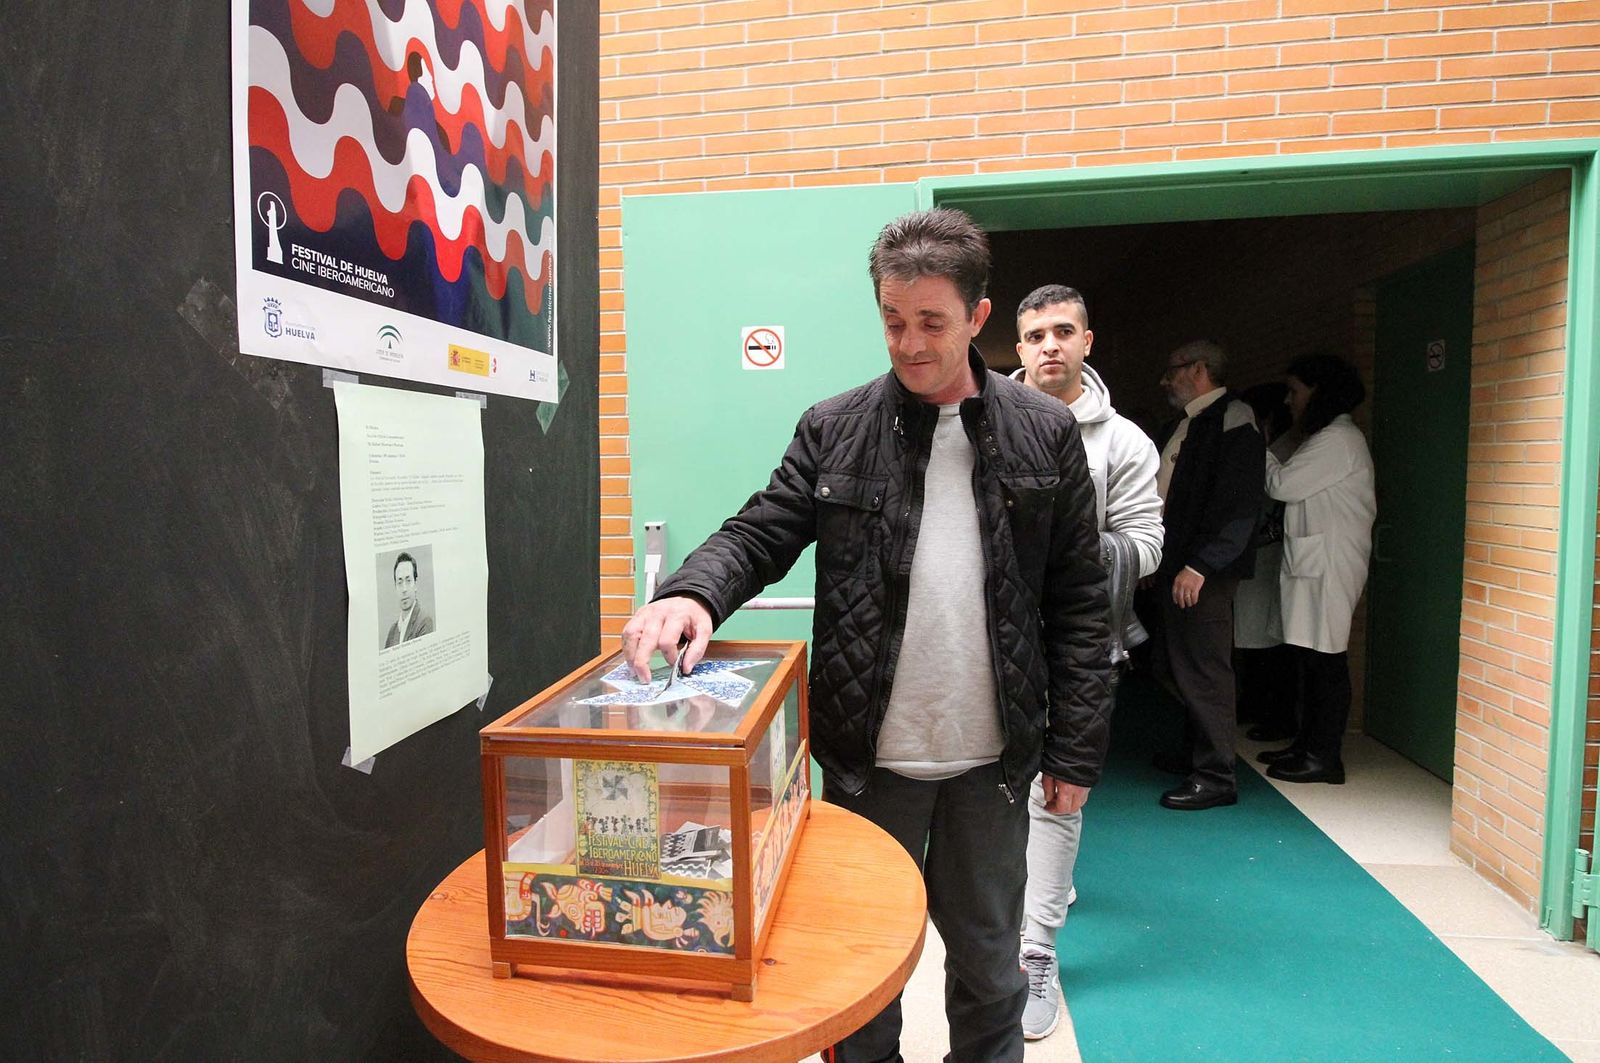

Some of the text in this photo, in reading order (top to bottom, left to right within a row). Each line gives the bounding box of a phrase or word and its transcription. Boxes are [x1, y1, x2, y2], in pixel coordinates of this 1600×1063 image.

[292, 243, 389, 285] FESTIVAL DE HUELVA
[292, 258, 395, 298] CINE IBEROAMERICANO
[285, 327, 316, 341] HUELVA
[588, 831, 624, 848] FESTIVAL
[624, 860, 660, 880] HUELVA
